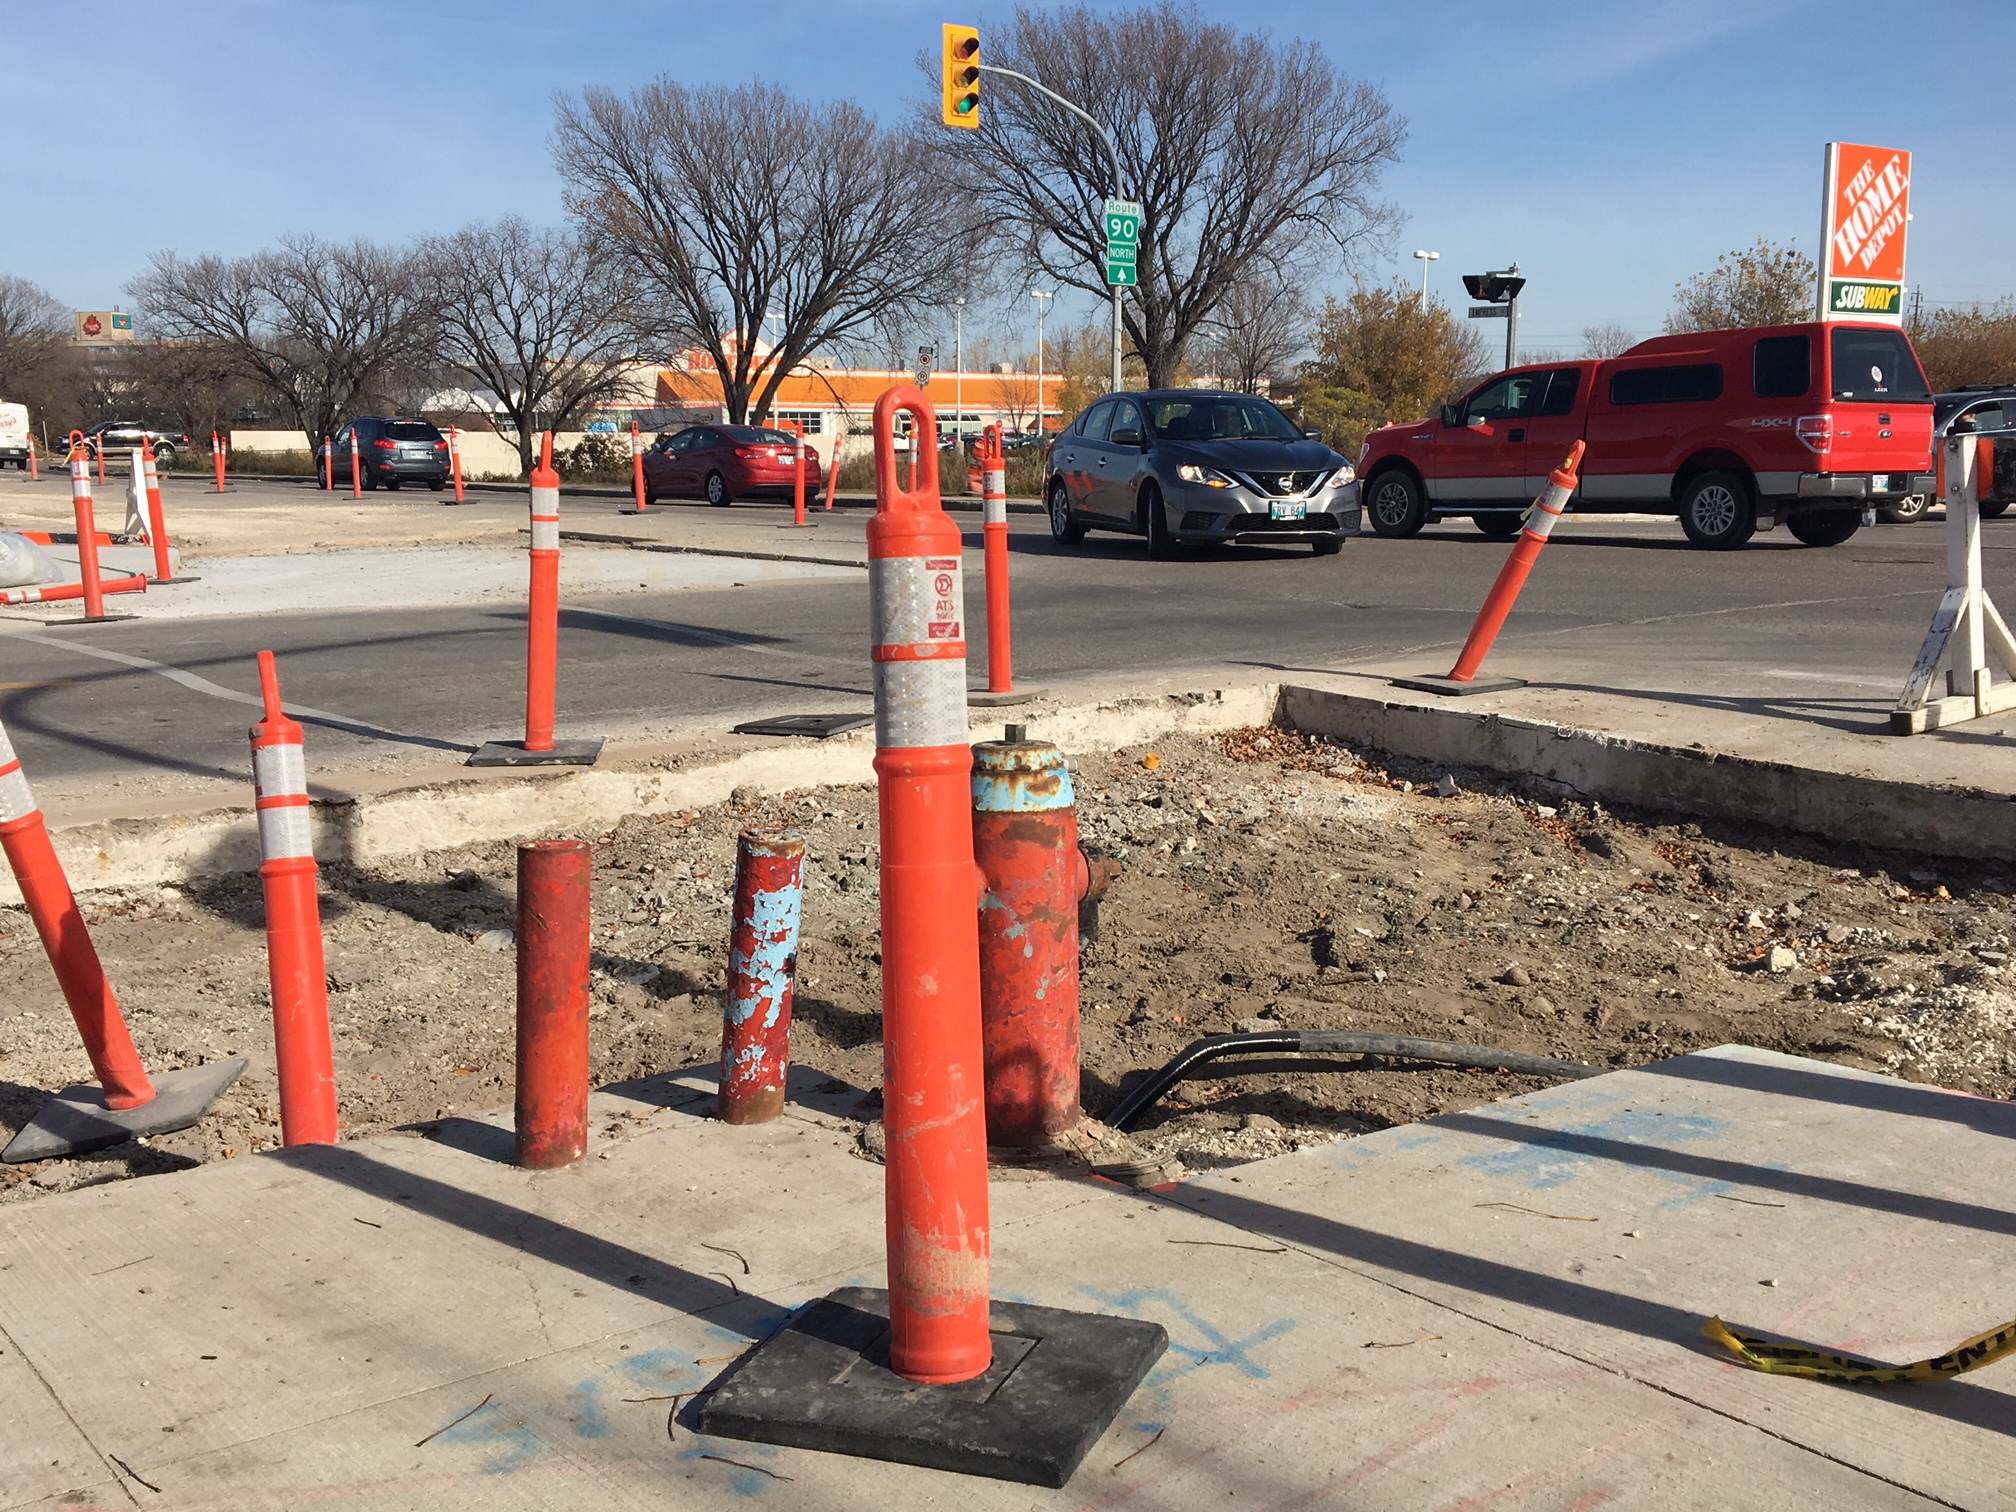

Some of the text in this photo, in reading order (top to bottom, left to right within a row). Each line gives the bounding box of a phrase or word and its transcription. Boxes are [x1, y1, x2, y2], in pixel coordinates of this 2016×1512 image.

[1844, 158, 1876, 207] THE
[1108, 201, 1137, 214] Route
[1834, 153, 1909, 267] HOME
[1110, 217, 1135, 239] 90
[1859, 202, 1904, 271] DEPOT
[1109, 247, 1135, 259] NORTH
[1836, 285, 1899, 311] SUBWAY
